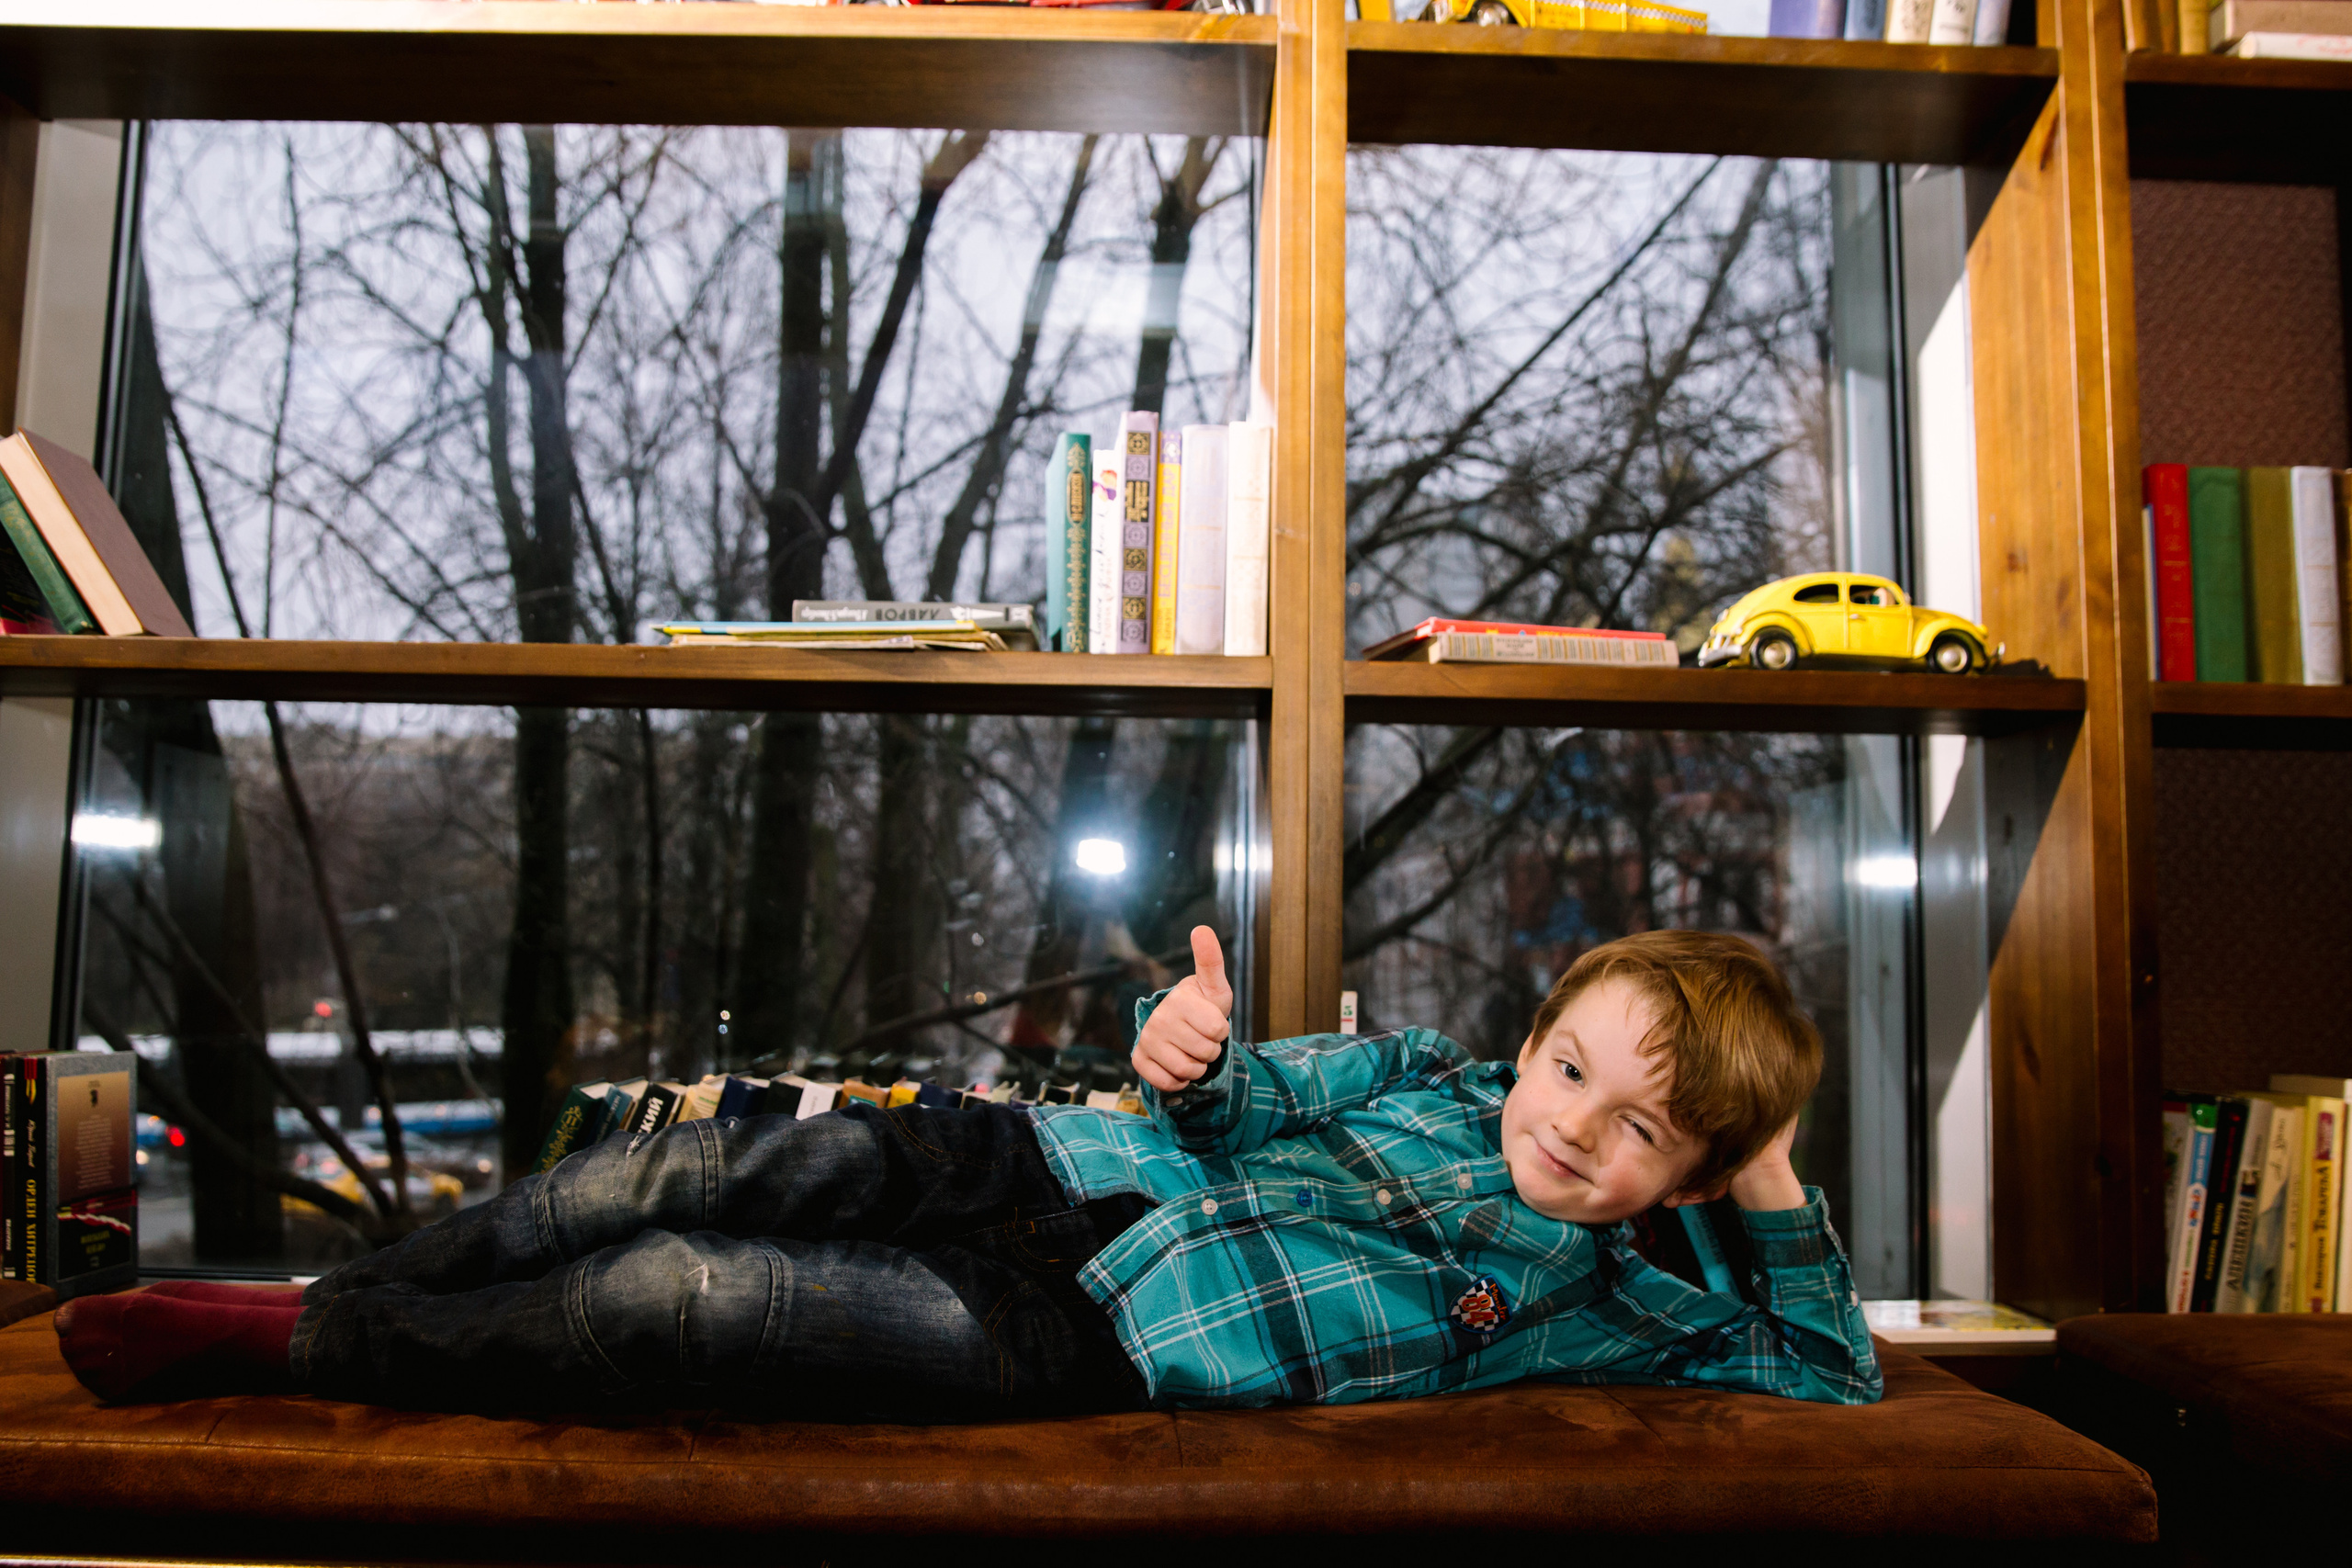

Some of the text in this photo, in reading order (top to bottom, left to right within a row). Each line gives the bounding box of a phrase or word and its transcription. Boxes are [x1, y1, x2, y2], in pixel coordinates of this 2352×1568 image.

[1162, 467, 1177, 498] ДАР
[876, 607, 941, 621] ЛАВРОВ
[1343, 1005, 1353, 1016] 5
[26, 1179, 37, 1218] ОРДЕН
[1462, 1294, 1496, 1325] 84
